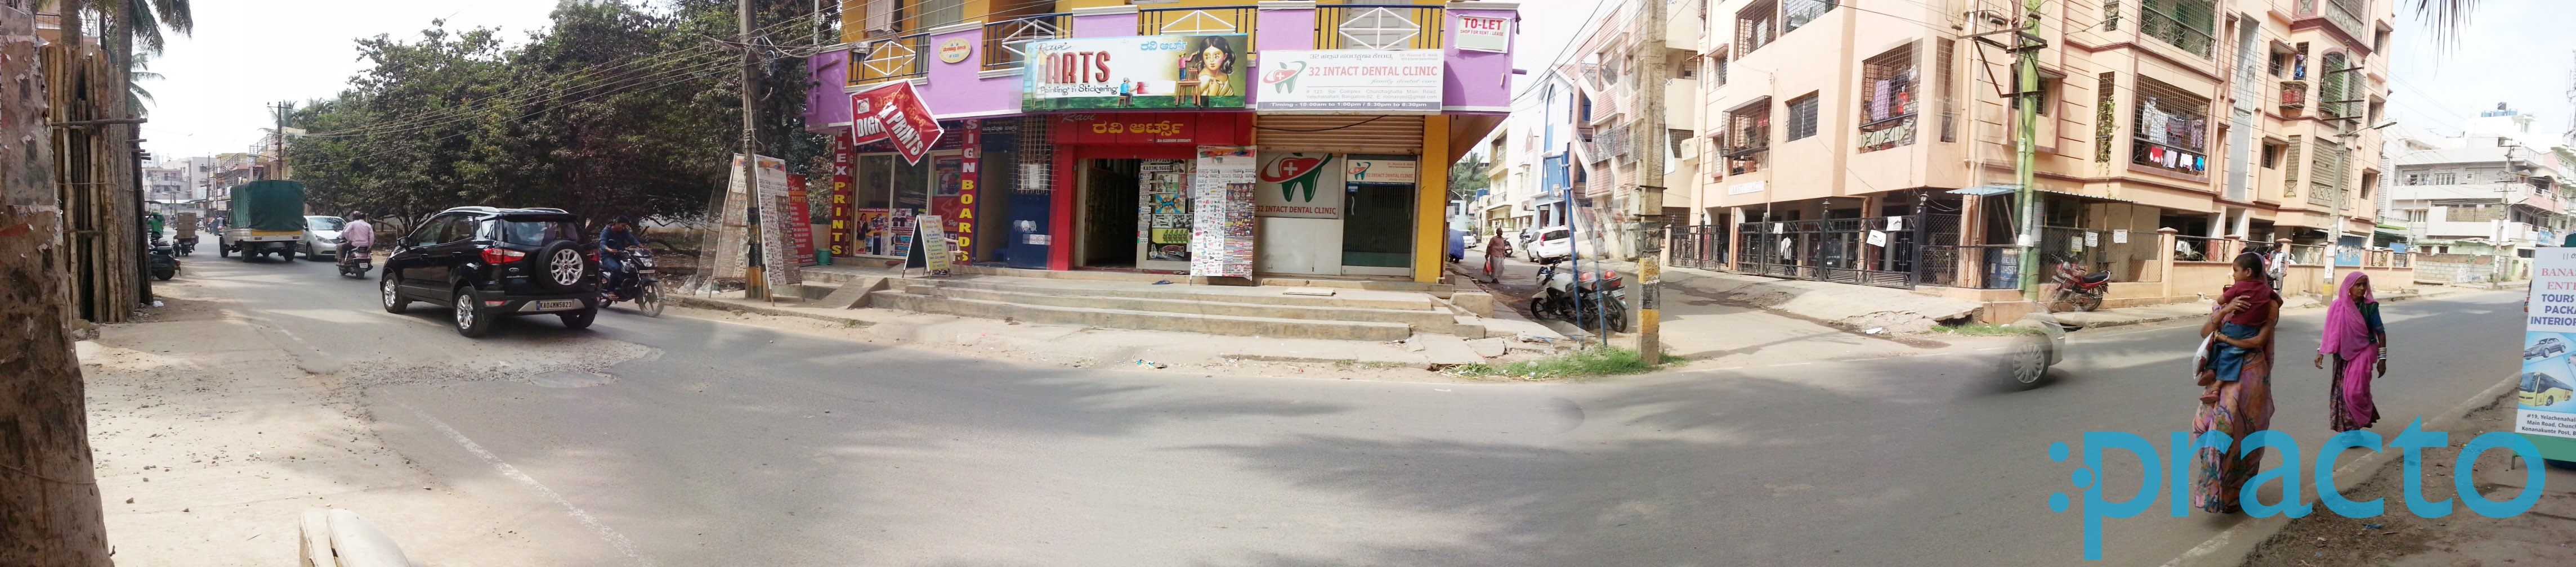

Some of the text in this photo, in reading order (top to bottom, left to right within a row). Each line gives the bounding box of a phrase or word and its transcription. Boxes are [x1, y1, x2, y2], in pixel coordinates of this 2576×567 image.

[1464, 18, 1502, 30] TO-LET
[1141, 40, 1157, 51] ರವಿ
[1046, 51, 1110, 84] ARTS
[1308, 66, 1437, 76] 32 INTACT DENTAL CLINIC
[1079, 84, 1118, 94] Stickering
[1062, 113, 1095, 123] Ravi
[1093, 120, 1124, 133] ರವಿ
[886, 111, 924, 156] PRINTS
[832, 128, 847, 254] FLEX PRINTS
[958, 119, 978, 262] SIGN BOARDS
[2542, 268, 2576, 277] BANA
[2542, 294, 2574, 303] TOURS
